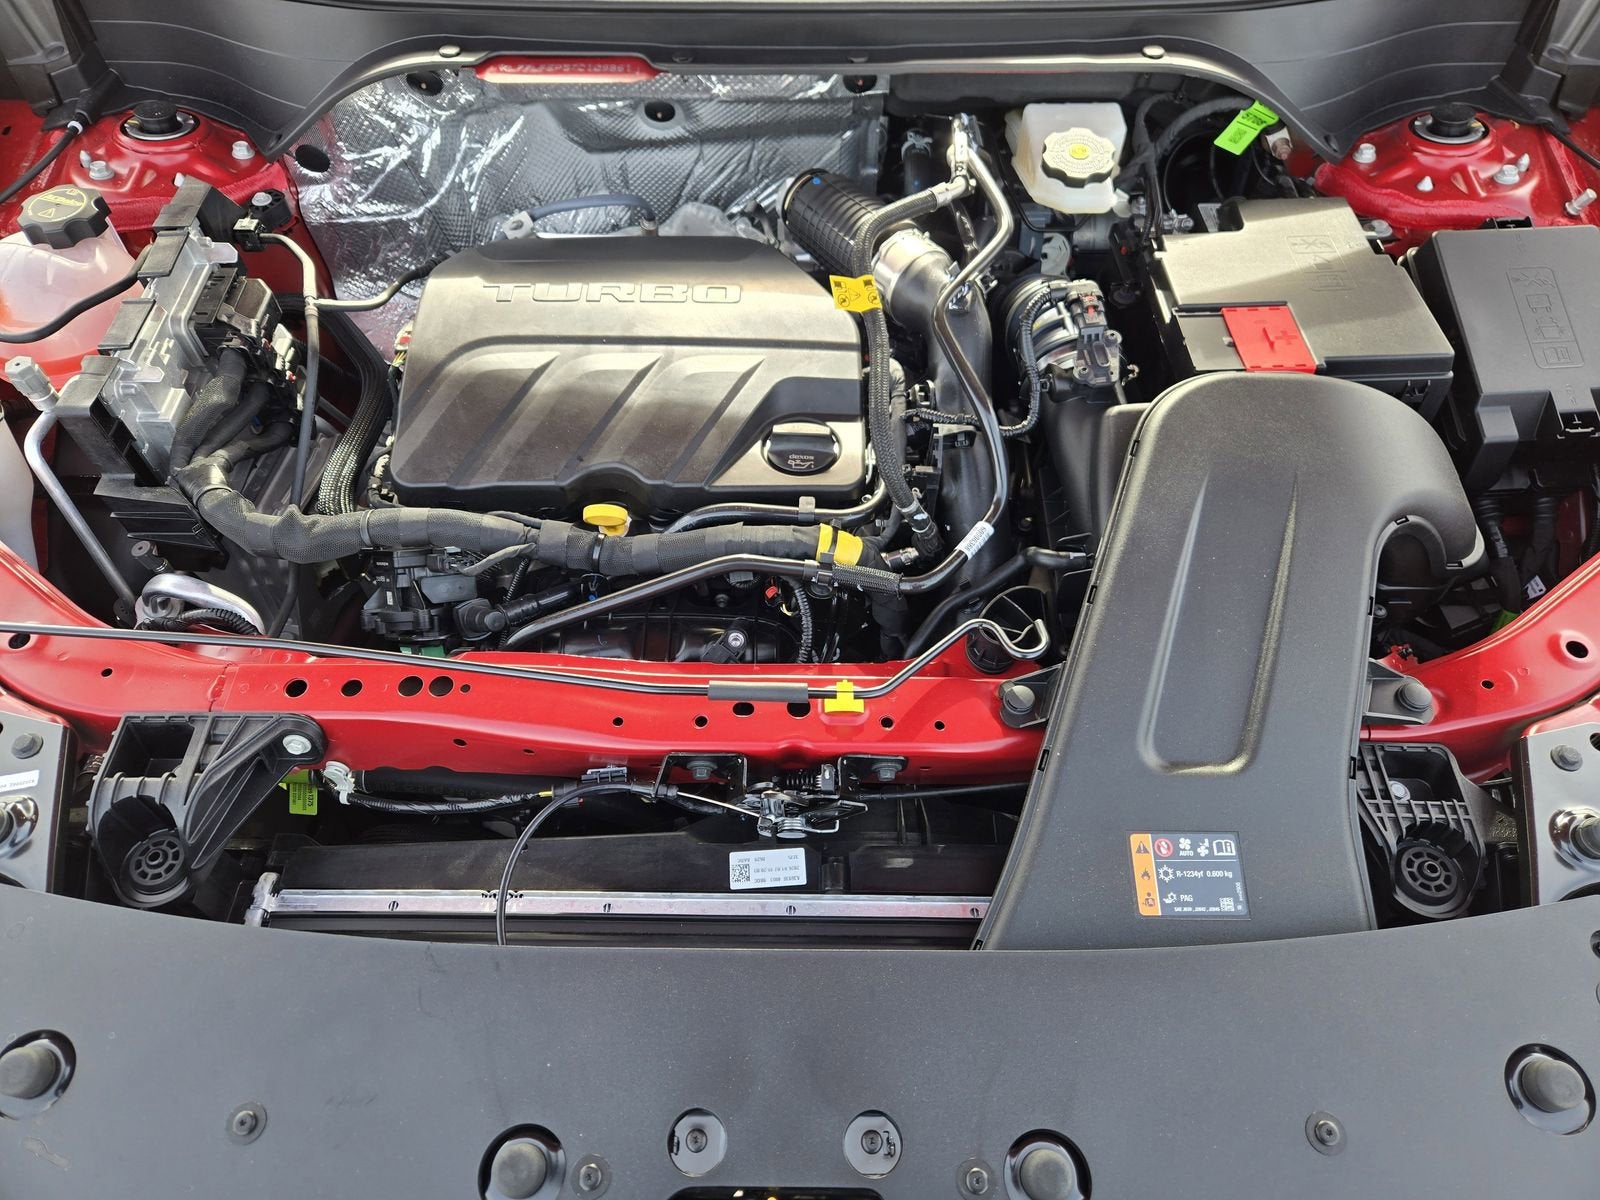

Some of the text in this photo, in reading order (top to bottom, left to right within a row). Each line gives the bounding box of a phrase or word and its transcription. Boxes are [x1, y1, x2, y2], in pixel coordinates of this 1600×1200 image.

[483, 282, 741, 304] TURBO
[1176, 870, 1204, 878] R-1234yf
[1224, 870, 1233, 878] kg
[1180, 894, 1193, 902] PAG
